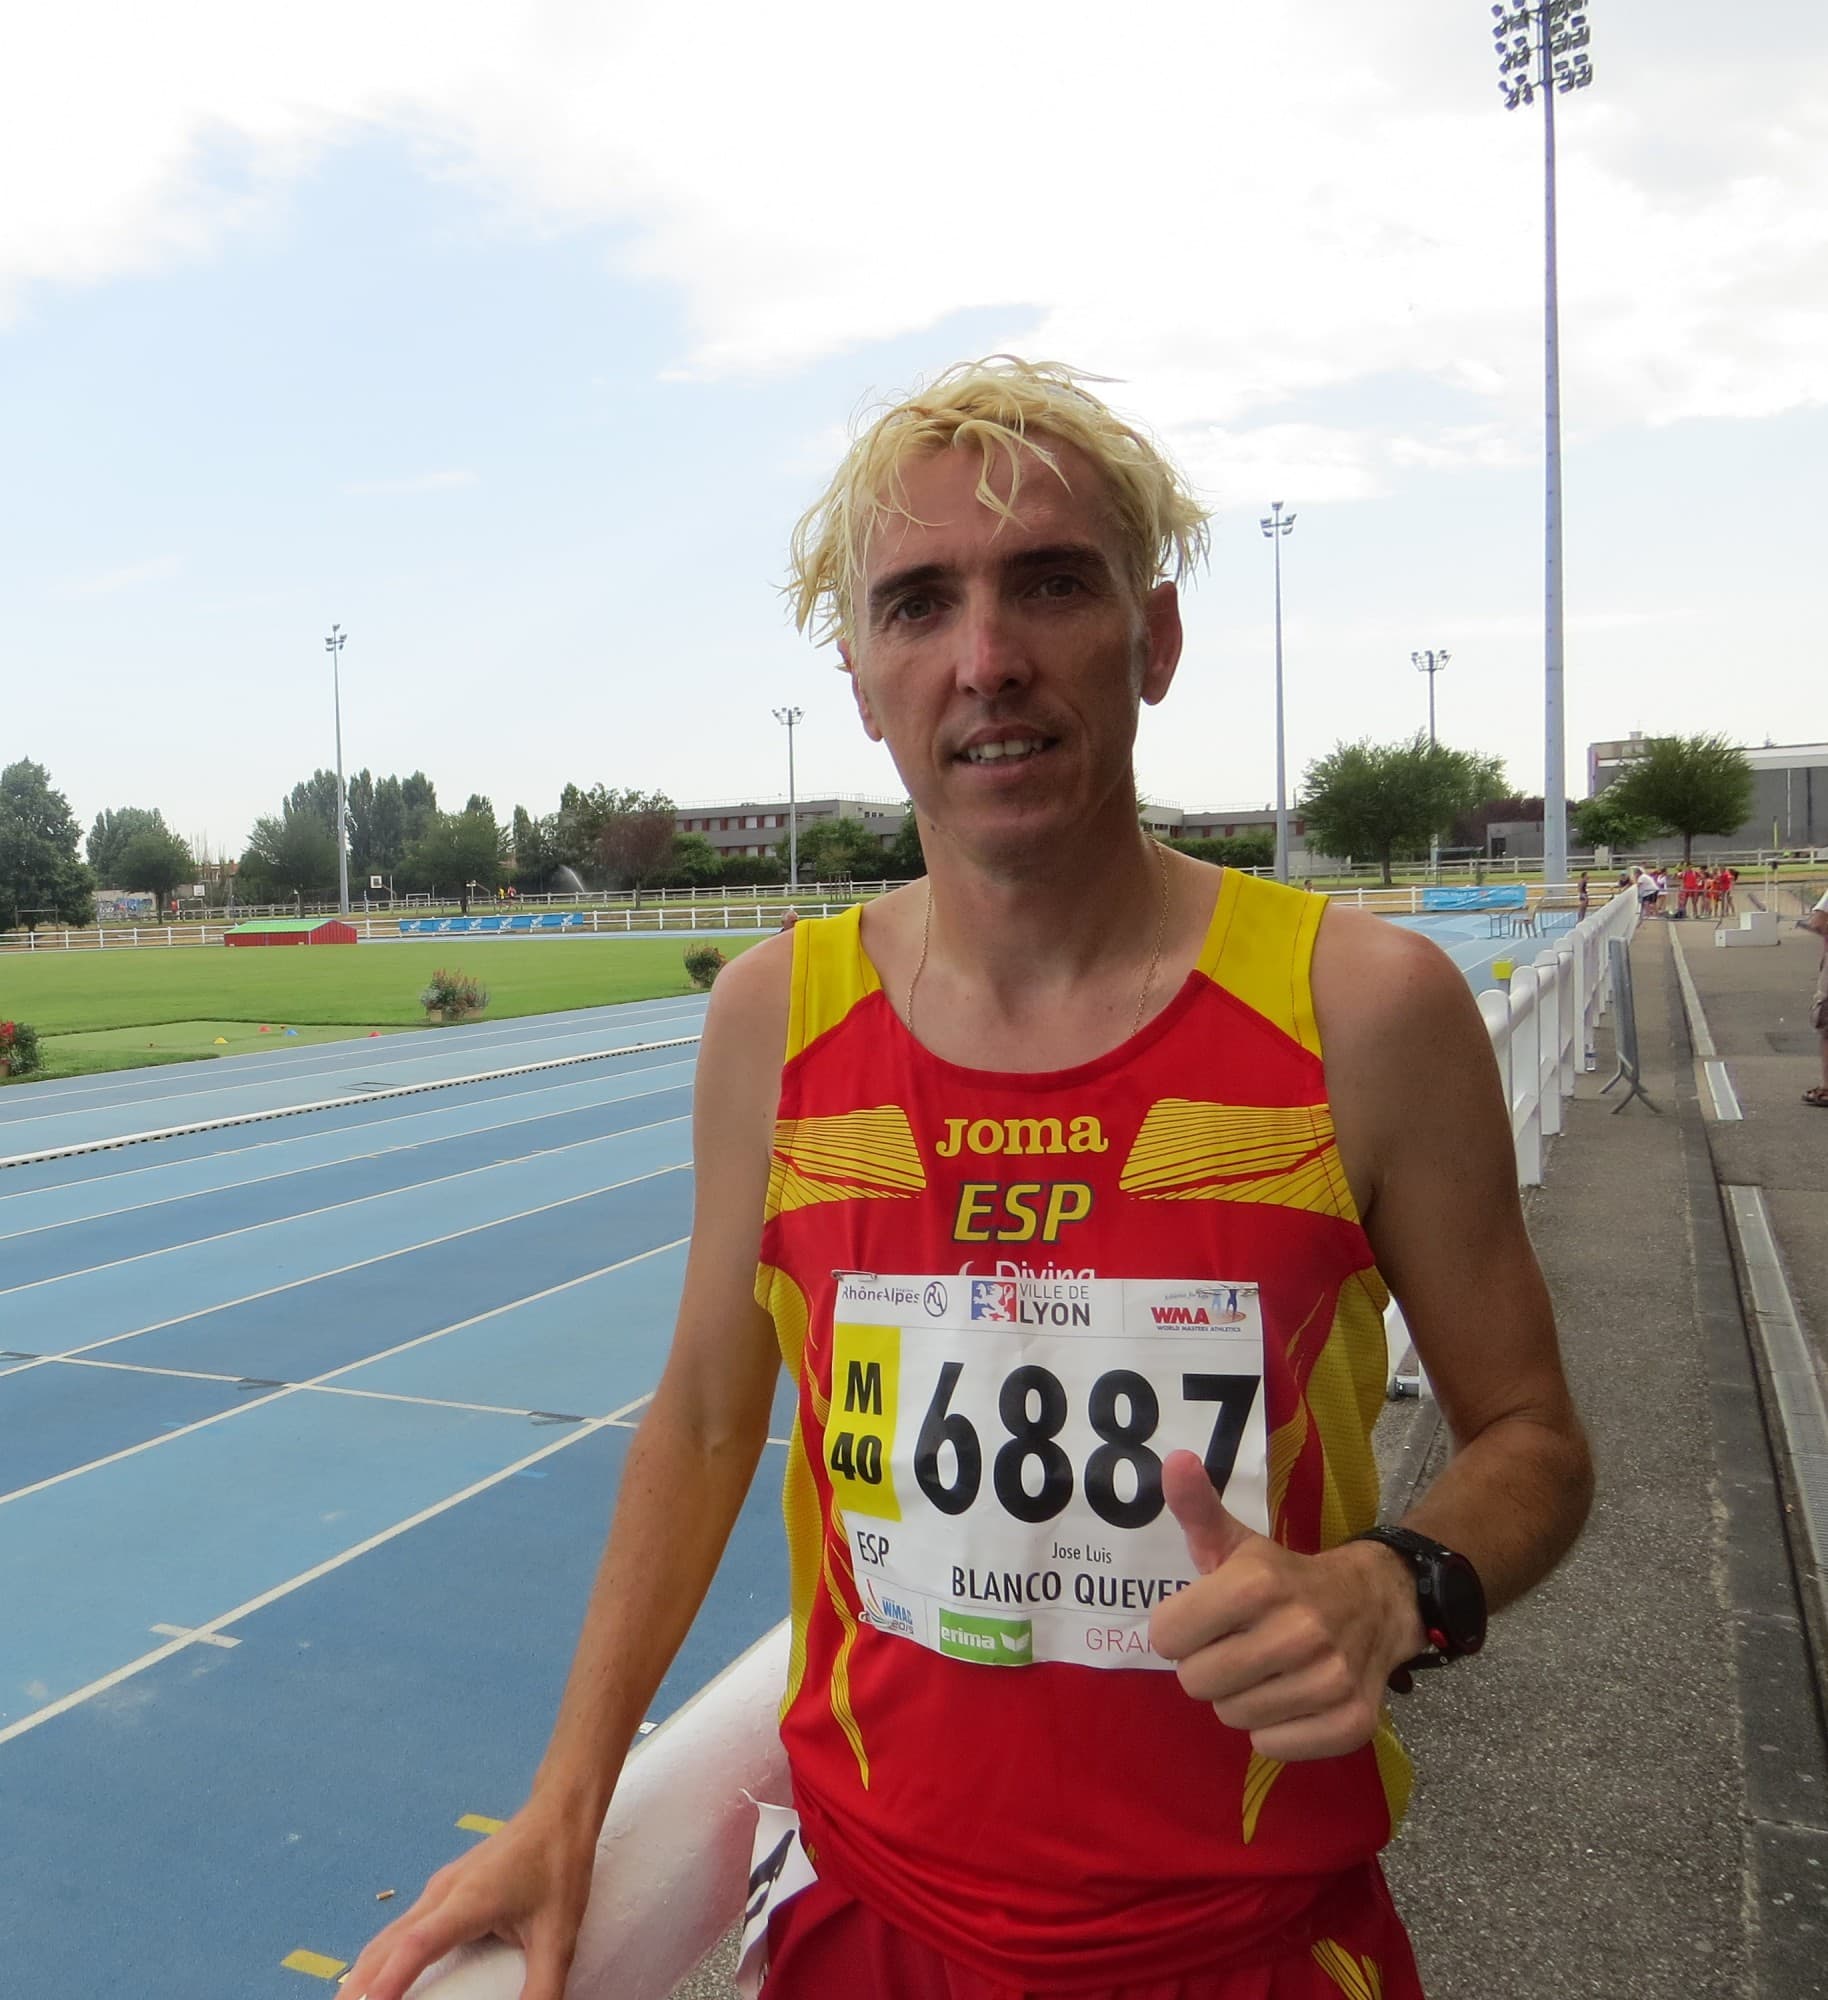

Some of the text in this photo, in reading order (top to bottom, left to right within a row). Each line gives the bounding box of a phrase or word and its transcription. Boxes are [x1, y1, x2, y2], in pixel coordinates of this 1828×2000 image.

[936, 1115, 1109, 1157] Joma
[951, 1180, 1094, 1243] ESP
[1019, 1283, 1089, 1299] VILLE DE
[1020, 1302, 1091, 1327] LYON
[1151, 1307, 1210, 1324] WMA
[844, 1360, 882, 1415] M
[831, 1431, 882, 1485] 40
[914, 1361, 1261, 1529] 6887
[857, 1531, 890, 1567] ESP
[1052, 1542, 1112, 1564] Jose Luis
[952, 1566, 1062, 1604] BLANCO
[940, 1624, 996, 1650] erima
[1086, 1627, 1152, 1654] GRA
